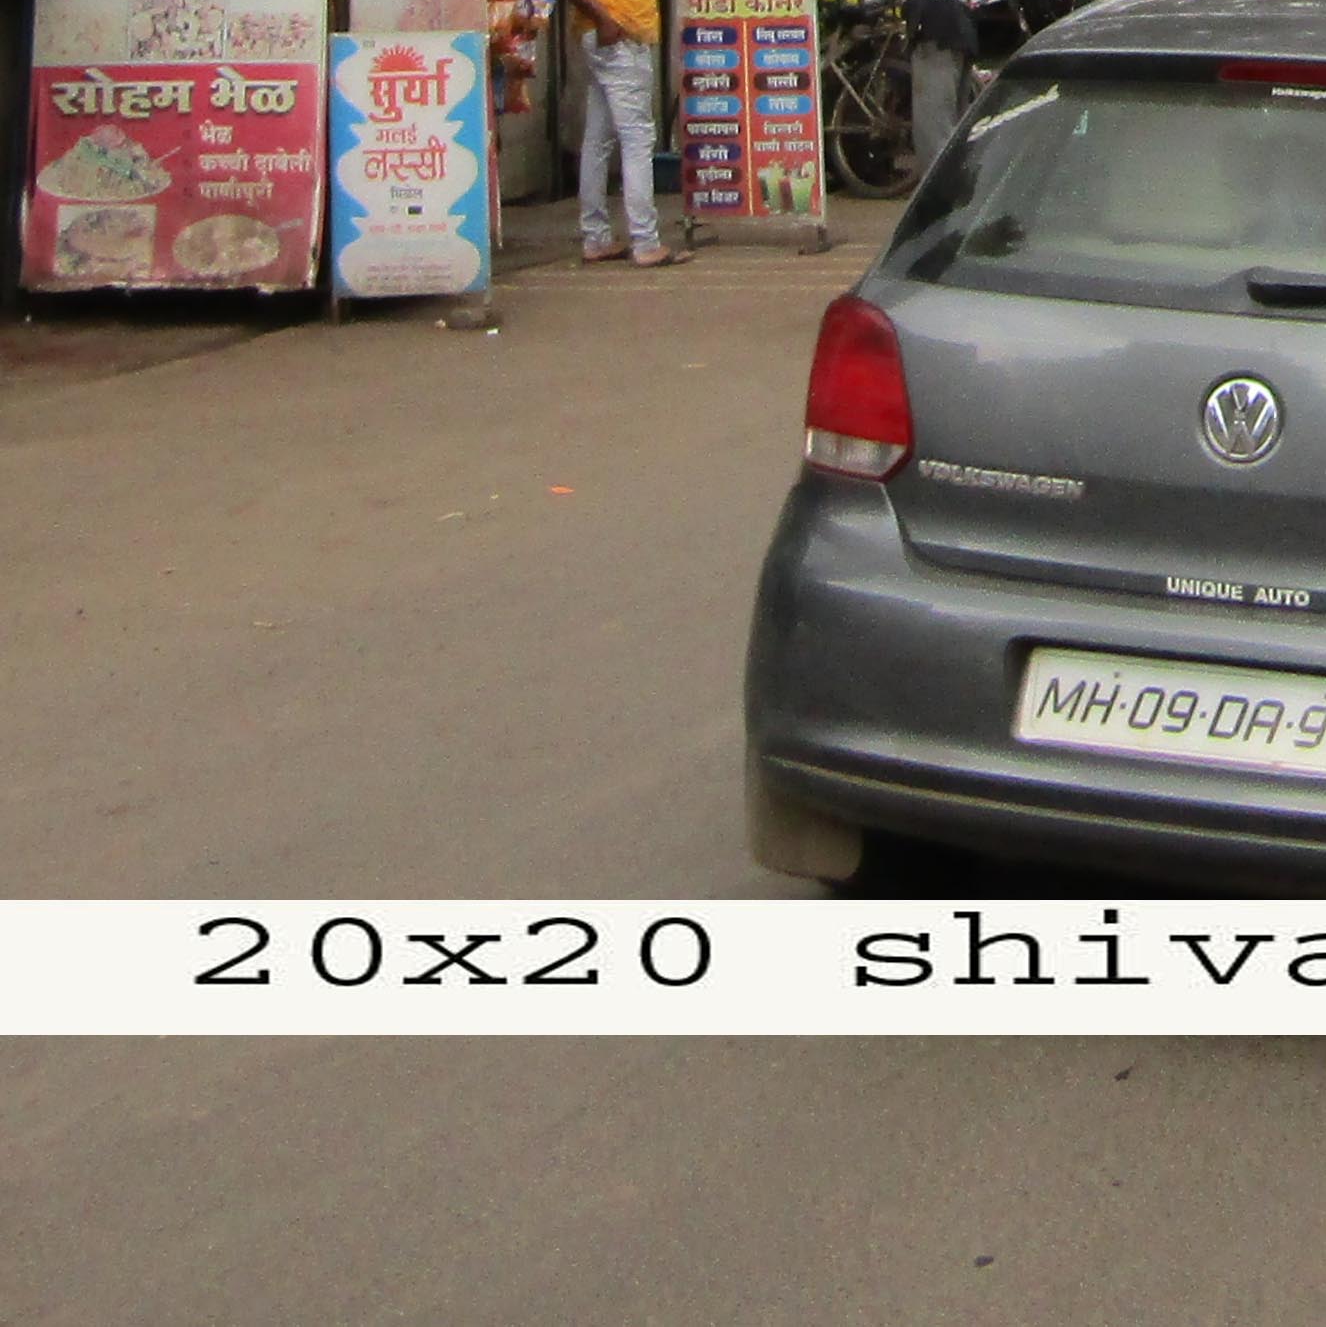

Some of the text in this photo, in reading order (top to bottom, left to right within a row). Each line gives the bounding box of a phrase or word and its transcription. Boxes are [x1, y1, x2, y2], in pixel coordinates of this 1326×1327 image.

[51, 66, 298, 119] सोहम भेळ
[368, 58, 453, 123] सुर्या
[376, 124, 418, 144] मलई
[362, 135, 447, 182] लस्सी
[918, 459, 1085, 498] VOLKSWAGEN
[1167, 576, 1311, 608] UNIQUE AUTO
